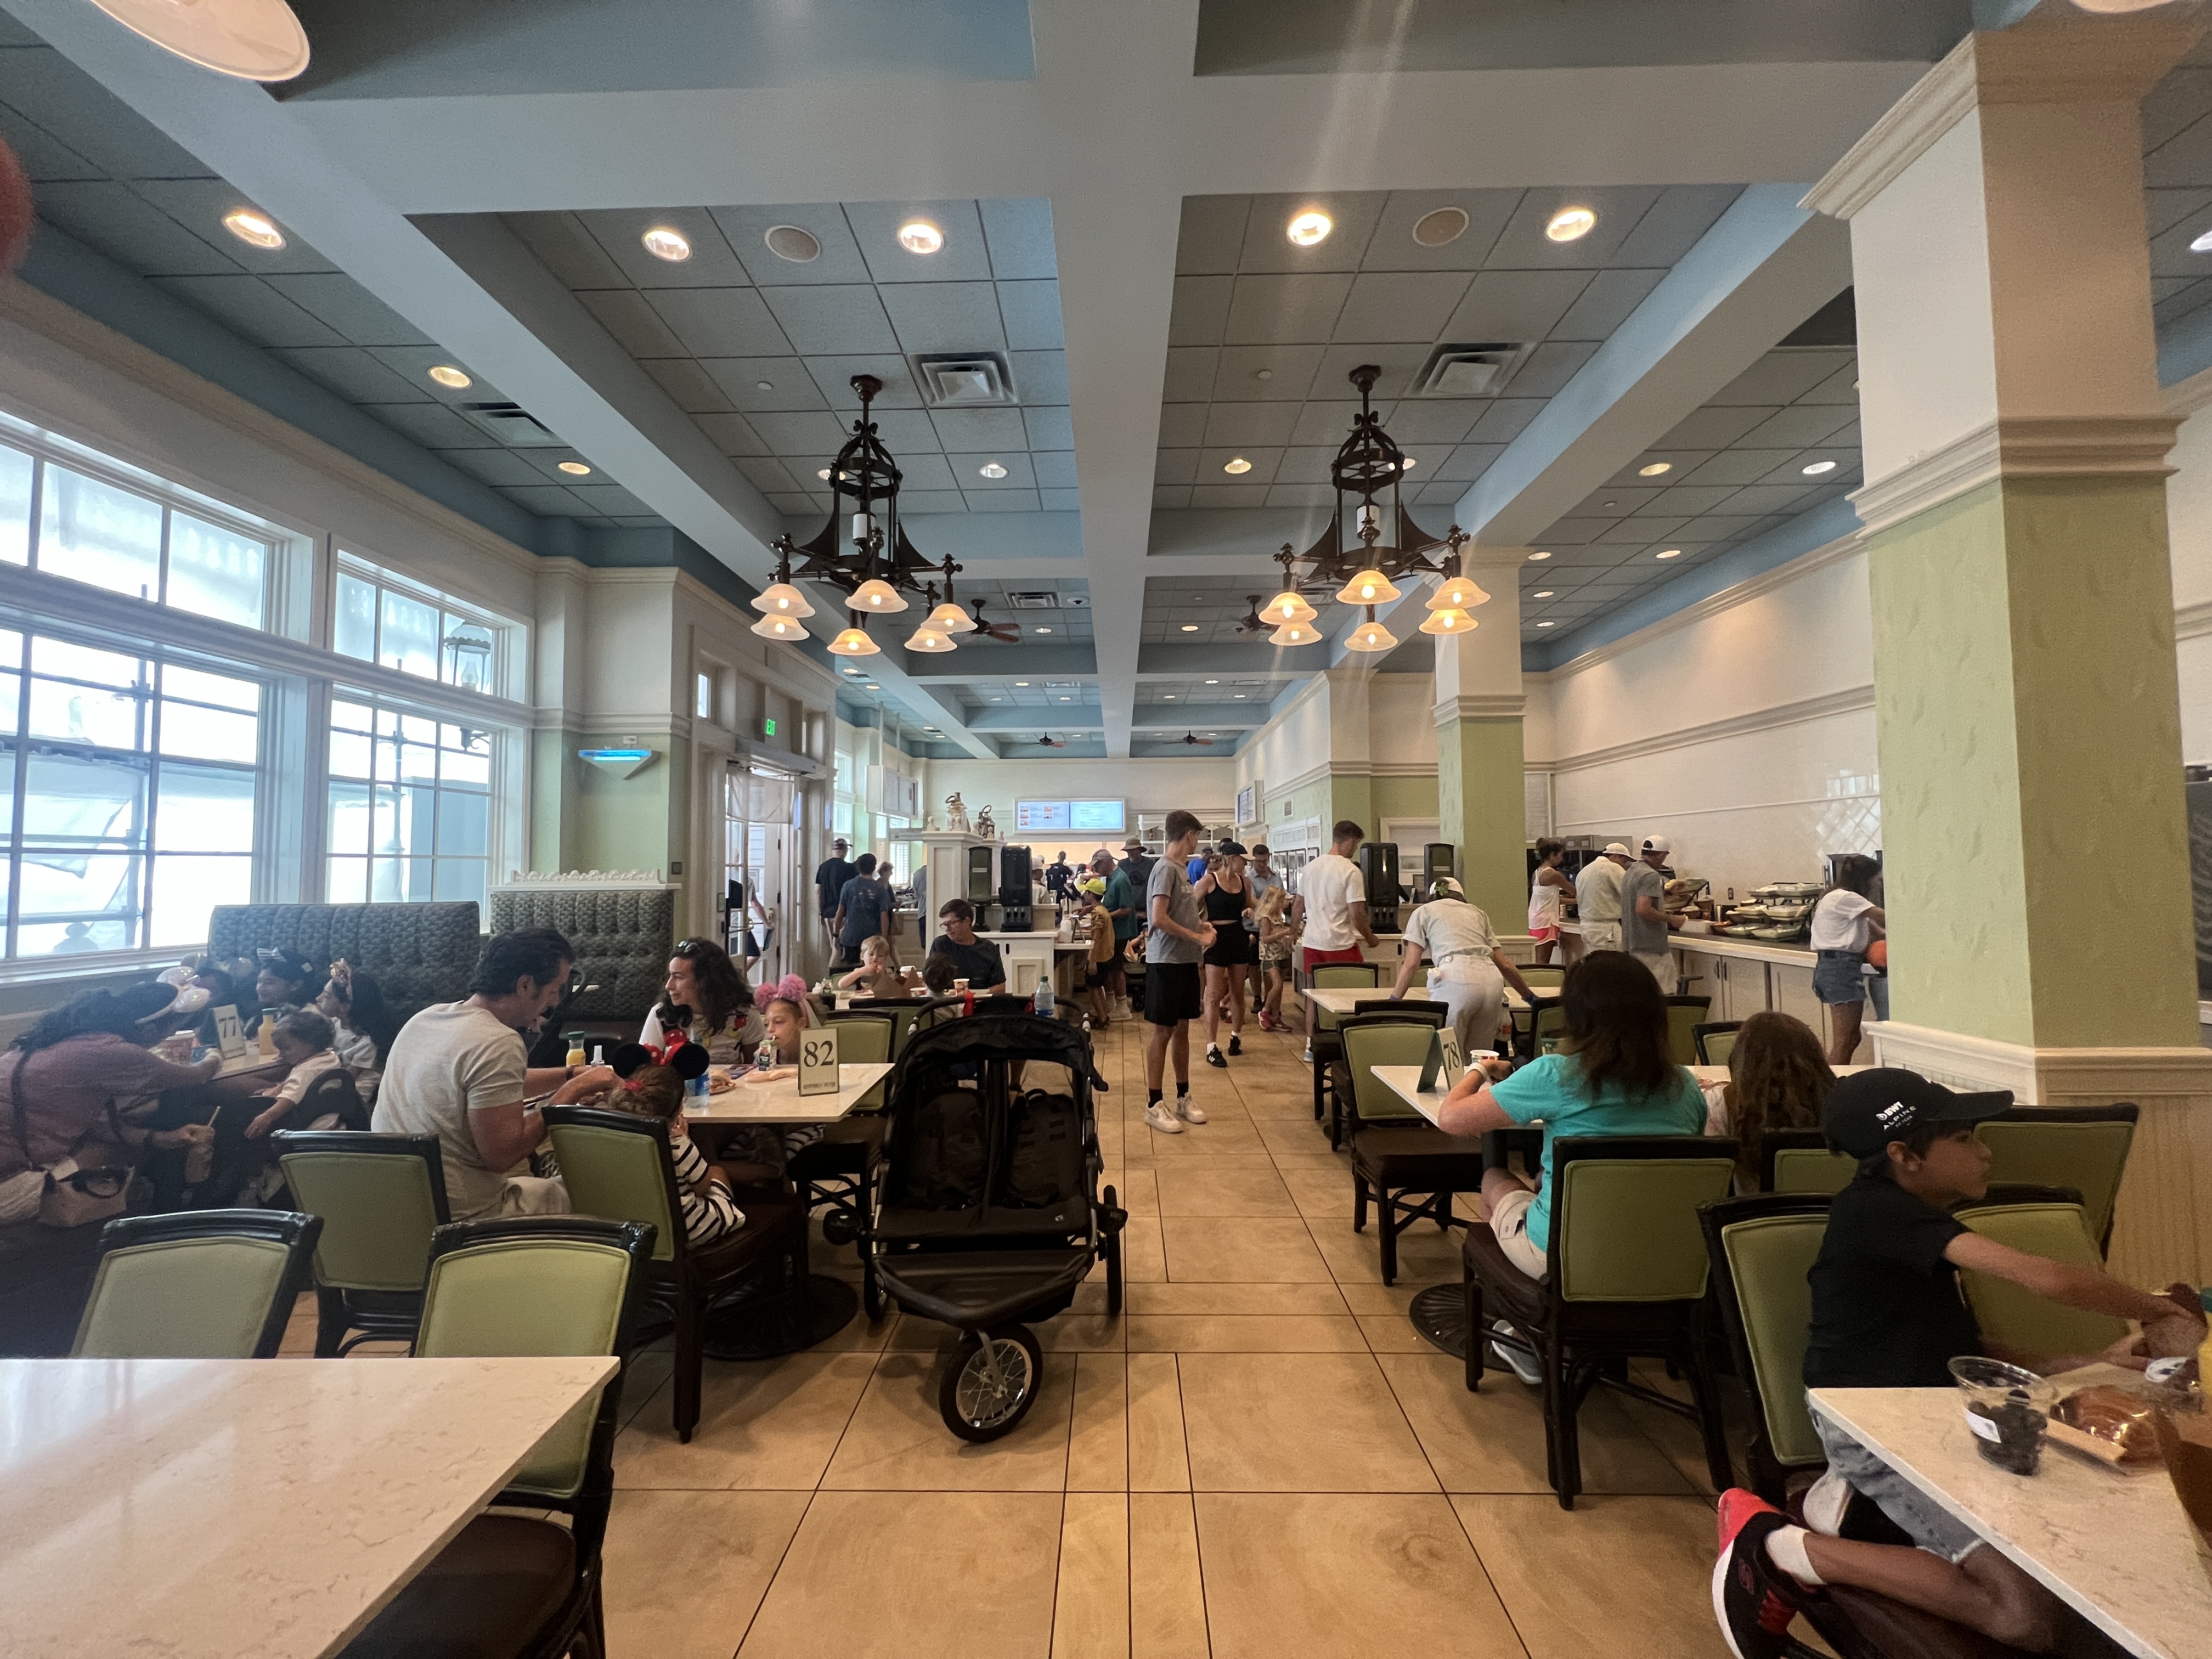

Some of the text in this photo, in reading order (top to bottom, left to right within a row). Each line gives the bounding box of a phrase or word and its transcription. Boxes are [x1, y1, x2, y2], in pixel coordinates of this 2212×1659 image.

[218, 1015, 236, 1039] 77
[804, 1040, 834, 1068] 82
[1443, 1041, 1460, 1071] 78
[1883, 1105, 1916, 1130] ALPINE
